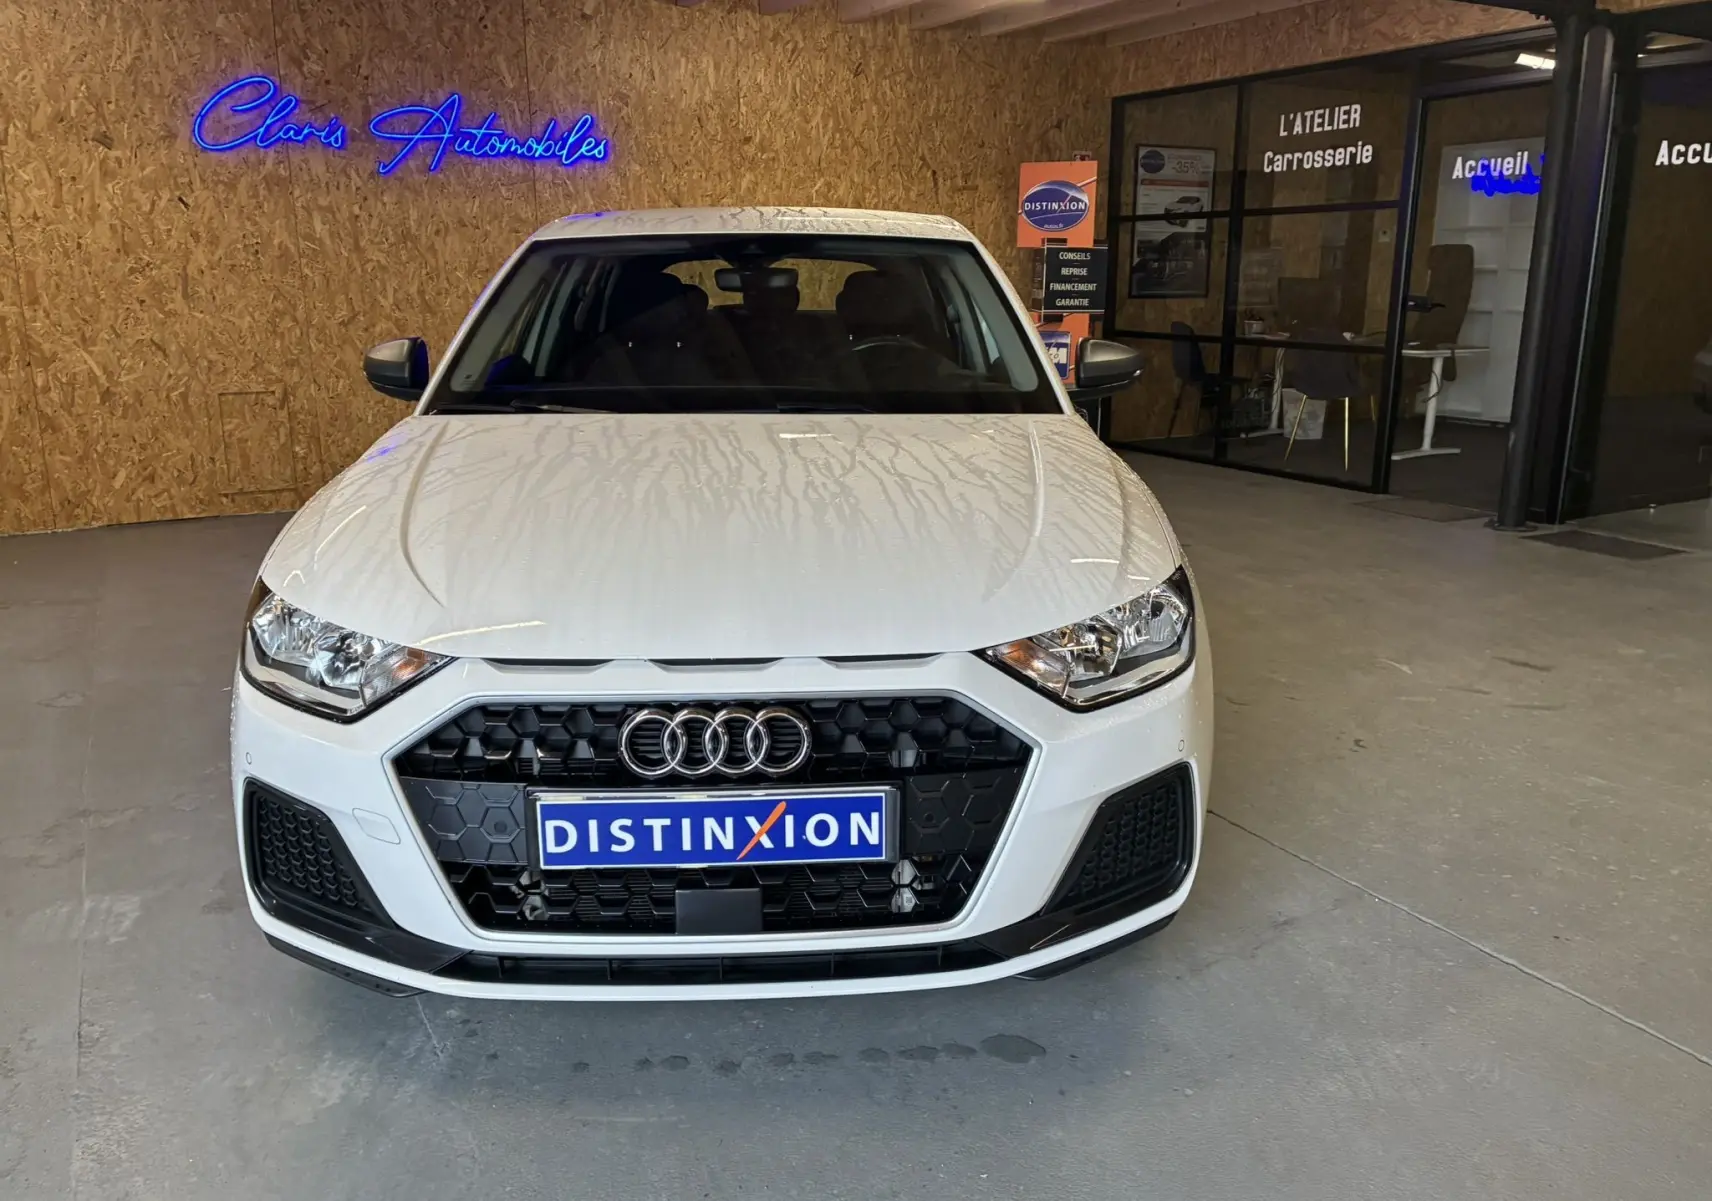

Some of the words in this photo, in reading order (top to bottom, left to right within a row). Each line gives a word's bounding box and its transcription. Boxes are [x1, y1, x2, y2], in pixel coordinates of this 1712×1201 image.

[193, 75, 346, 150] Claris
[368, 93, 609, 174] Automobiles
[1279, 104, 1362, 137] L'ATELIER
[1263, 140, 1374, 173] Carrosserie
[1451, 150, 1529, 180] Accueil
[1024, 200, 1086, 212] DISTINXION
[1058, 251, 1091, 260] CONSEILS
[1060, 267, 1088, 276] REPRISE
[1049, 282, 1097, 291] FINANCEMENT
[1055, 298, 1090, 306] GARANTIE
[544, 810, 881, 855] DISTINXION
